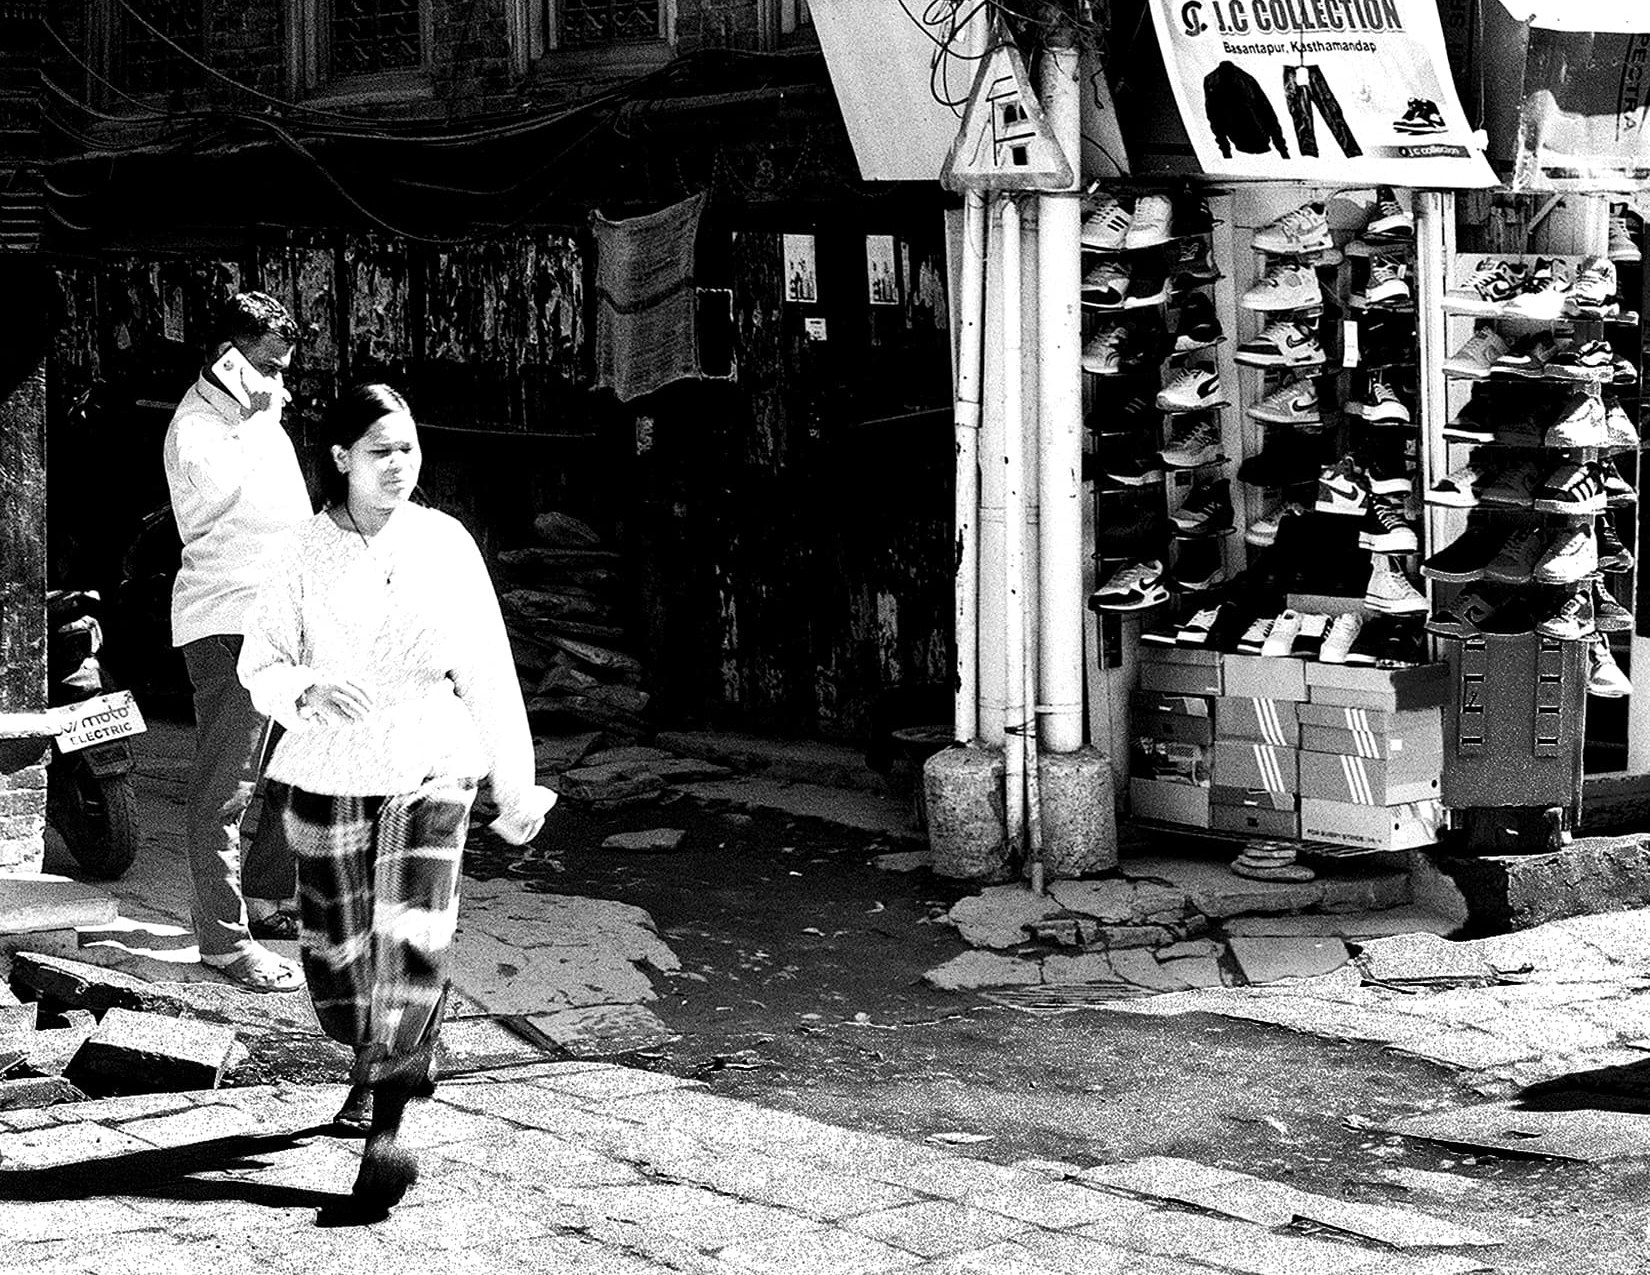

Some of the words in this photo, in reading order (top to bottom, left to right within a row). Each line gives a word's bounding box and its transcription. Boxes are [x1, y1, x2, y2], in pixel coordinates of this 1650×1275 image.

[1223, 41, 1289, 56] Basantapur,
[1290, 39, 1377, 54] Kasthamandap
[69, 721, 133, 746] ELECTRIC
